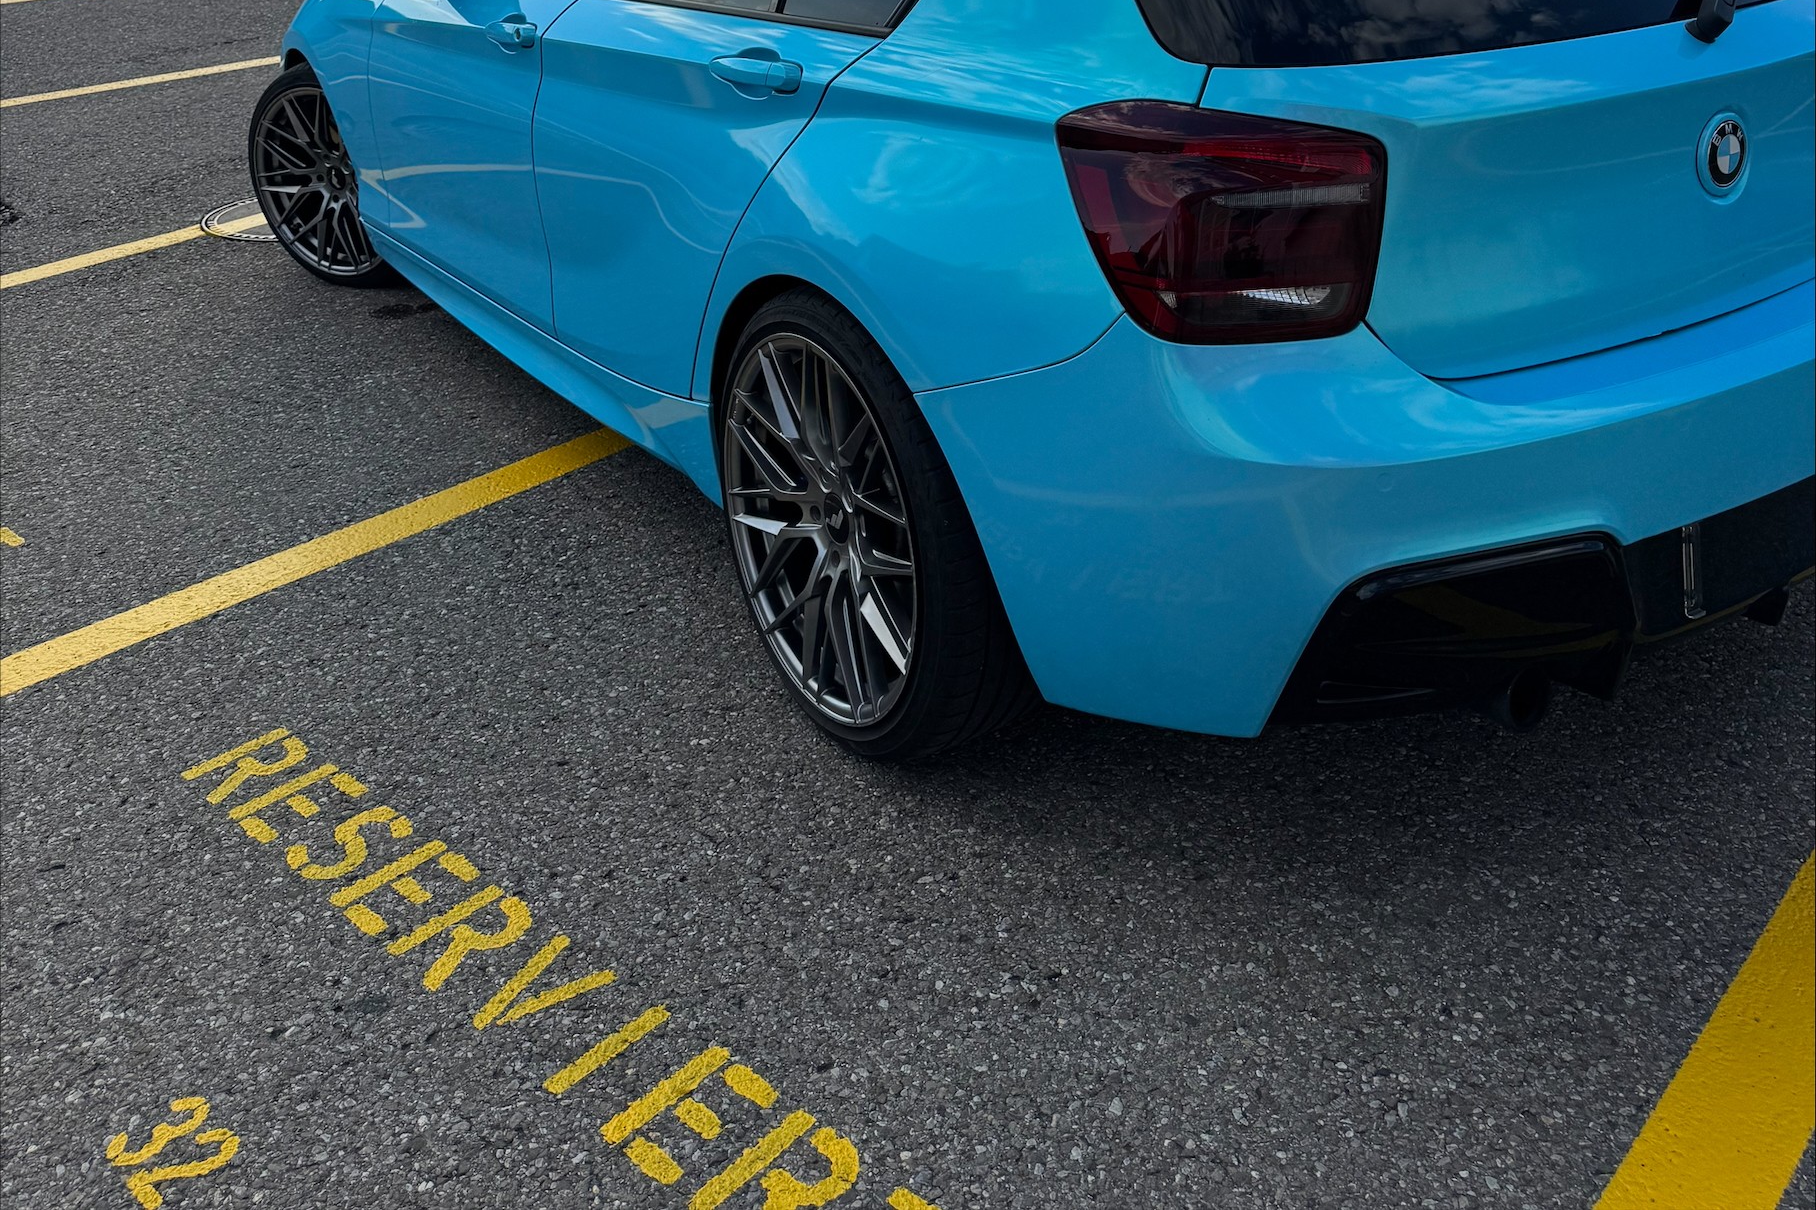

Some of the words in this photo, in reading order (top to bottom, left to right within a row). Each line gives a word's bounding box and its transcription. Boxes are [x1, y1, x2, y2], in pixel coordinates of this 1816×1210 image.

[1712, 123, 1743, 146] BMW
[182, 728, 940, 1210] RESERVIER
[106, 1096, 240, 1210] 32
